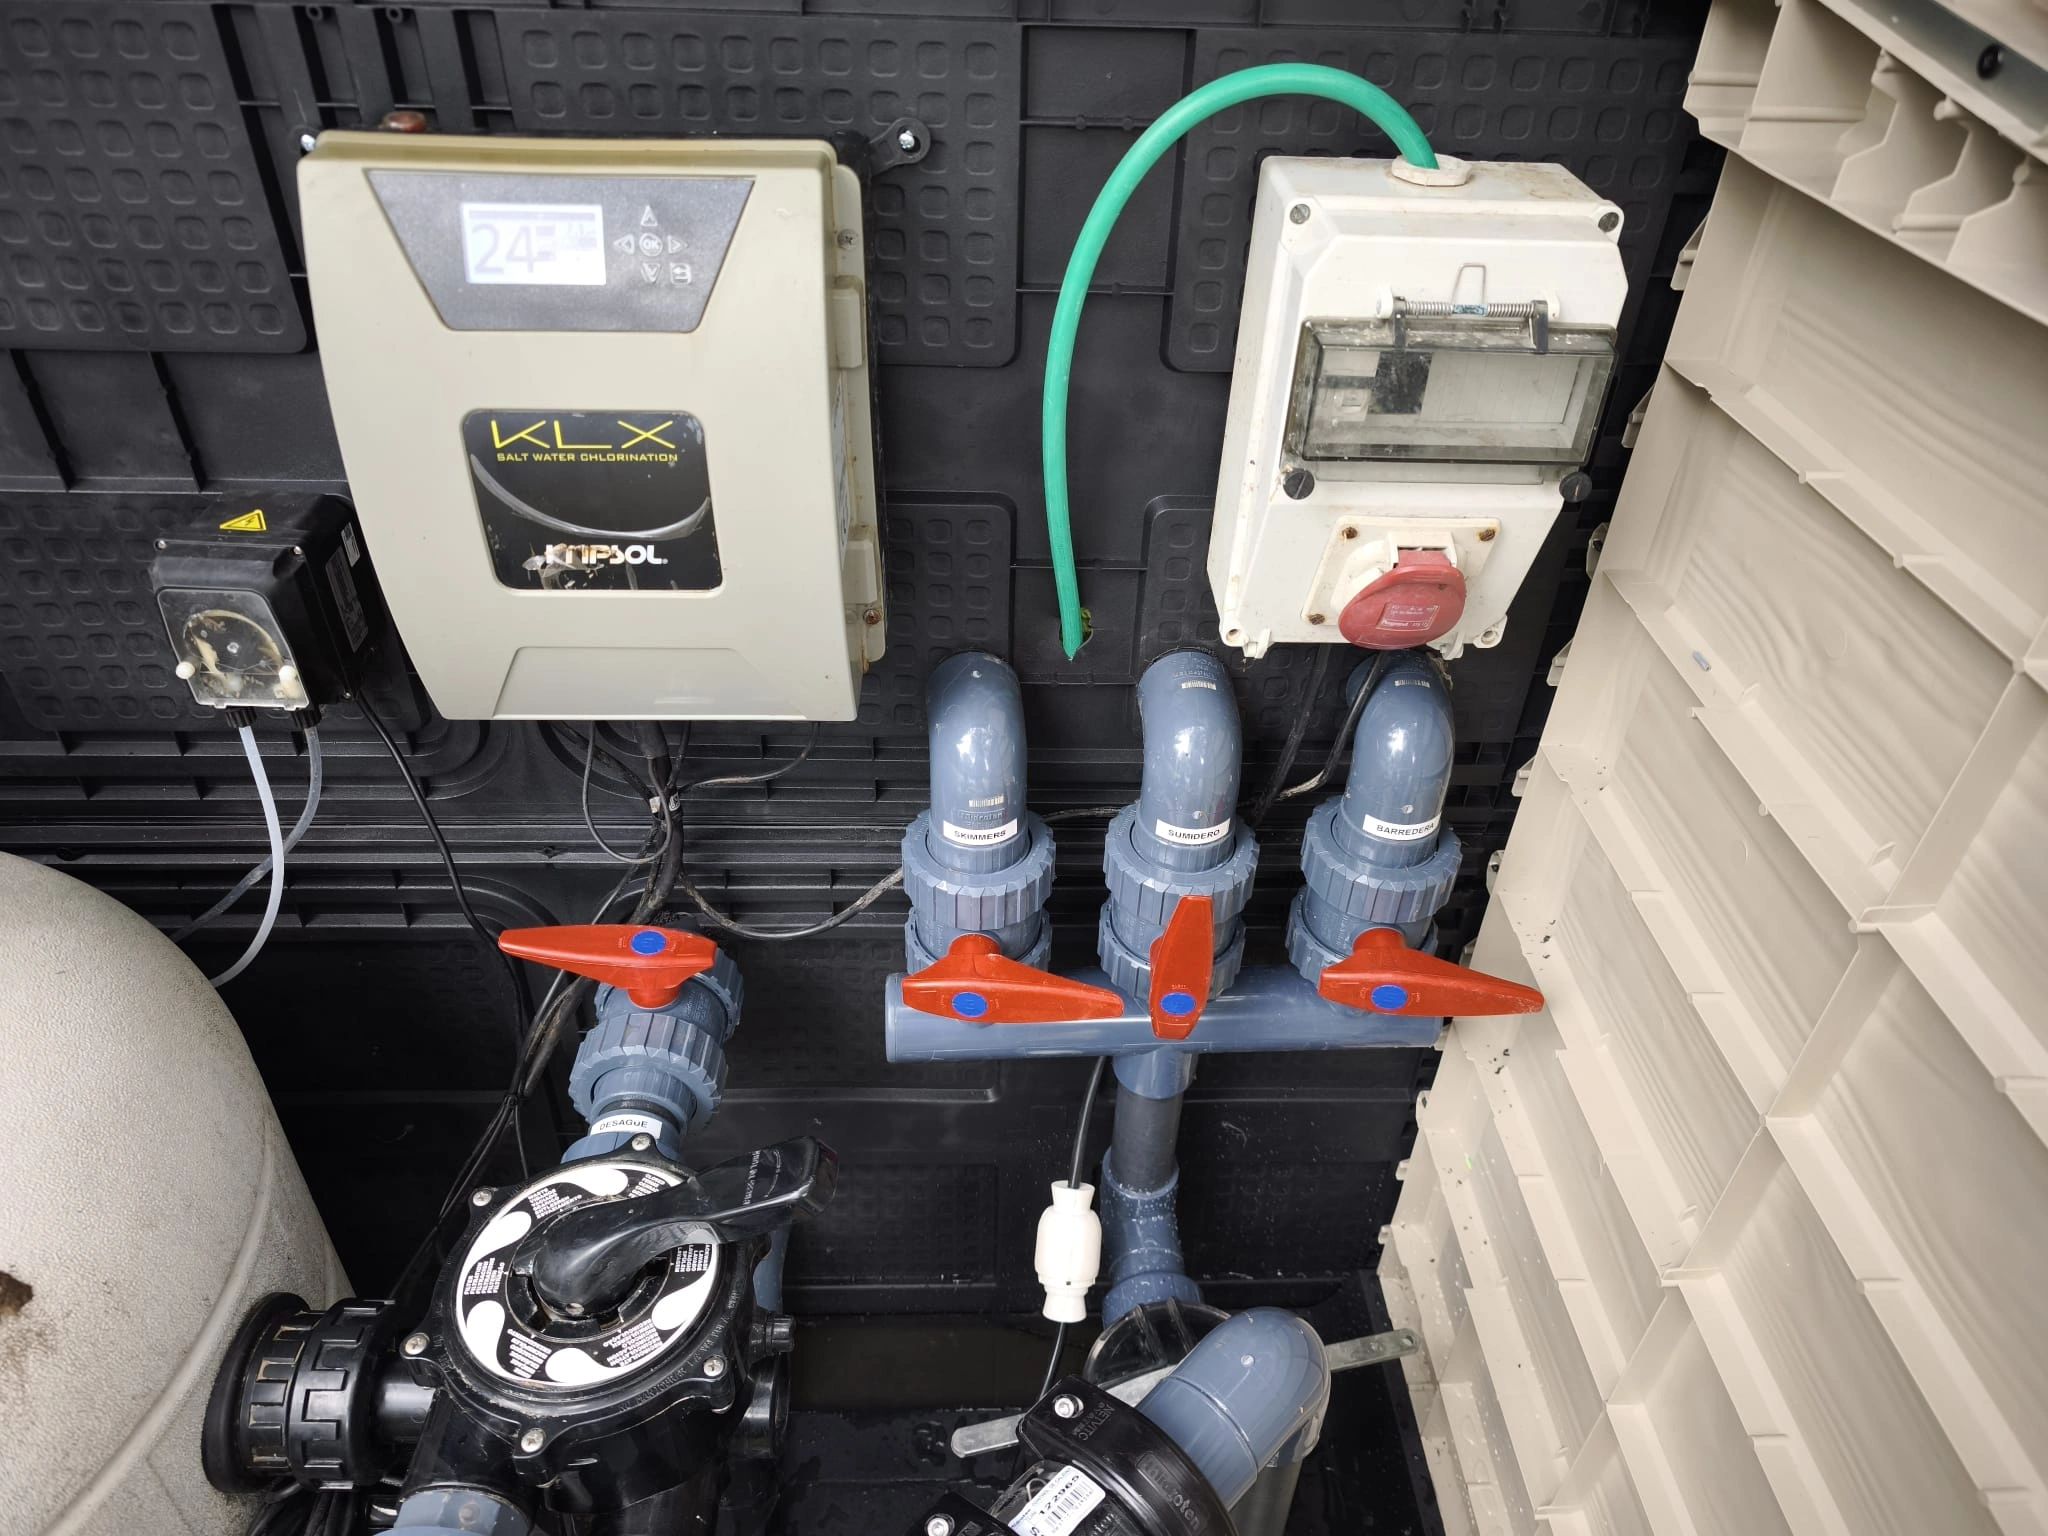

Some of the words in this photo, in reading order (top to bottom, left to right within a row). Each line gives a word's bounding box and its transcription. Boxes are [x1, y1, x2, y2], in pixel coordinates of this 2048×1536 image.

[490, 419, 676, 449] KLX
[496, 453, 529, 462] SALT
[534, 453, 576, 462] WATER
[580, 453, 679, 462] CHLORINATION
[954, 829, 1007, 841] SKIMMERS
[1167, 827, 1221, 841] SUMIDERO
[1376, 822, 1435, 837] BARREDERA
[1038, 1472, 1080, 1516] 122965
